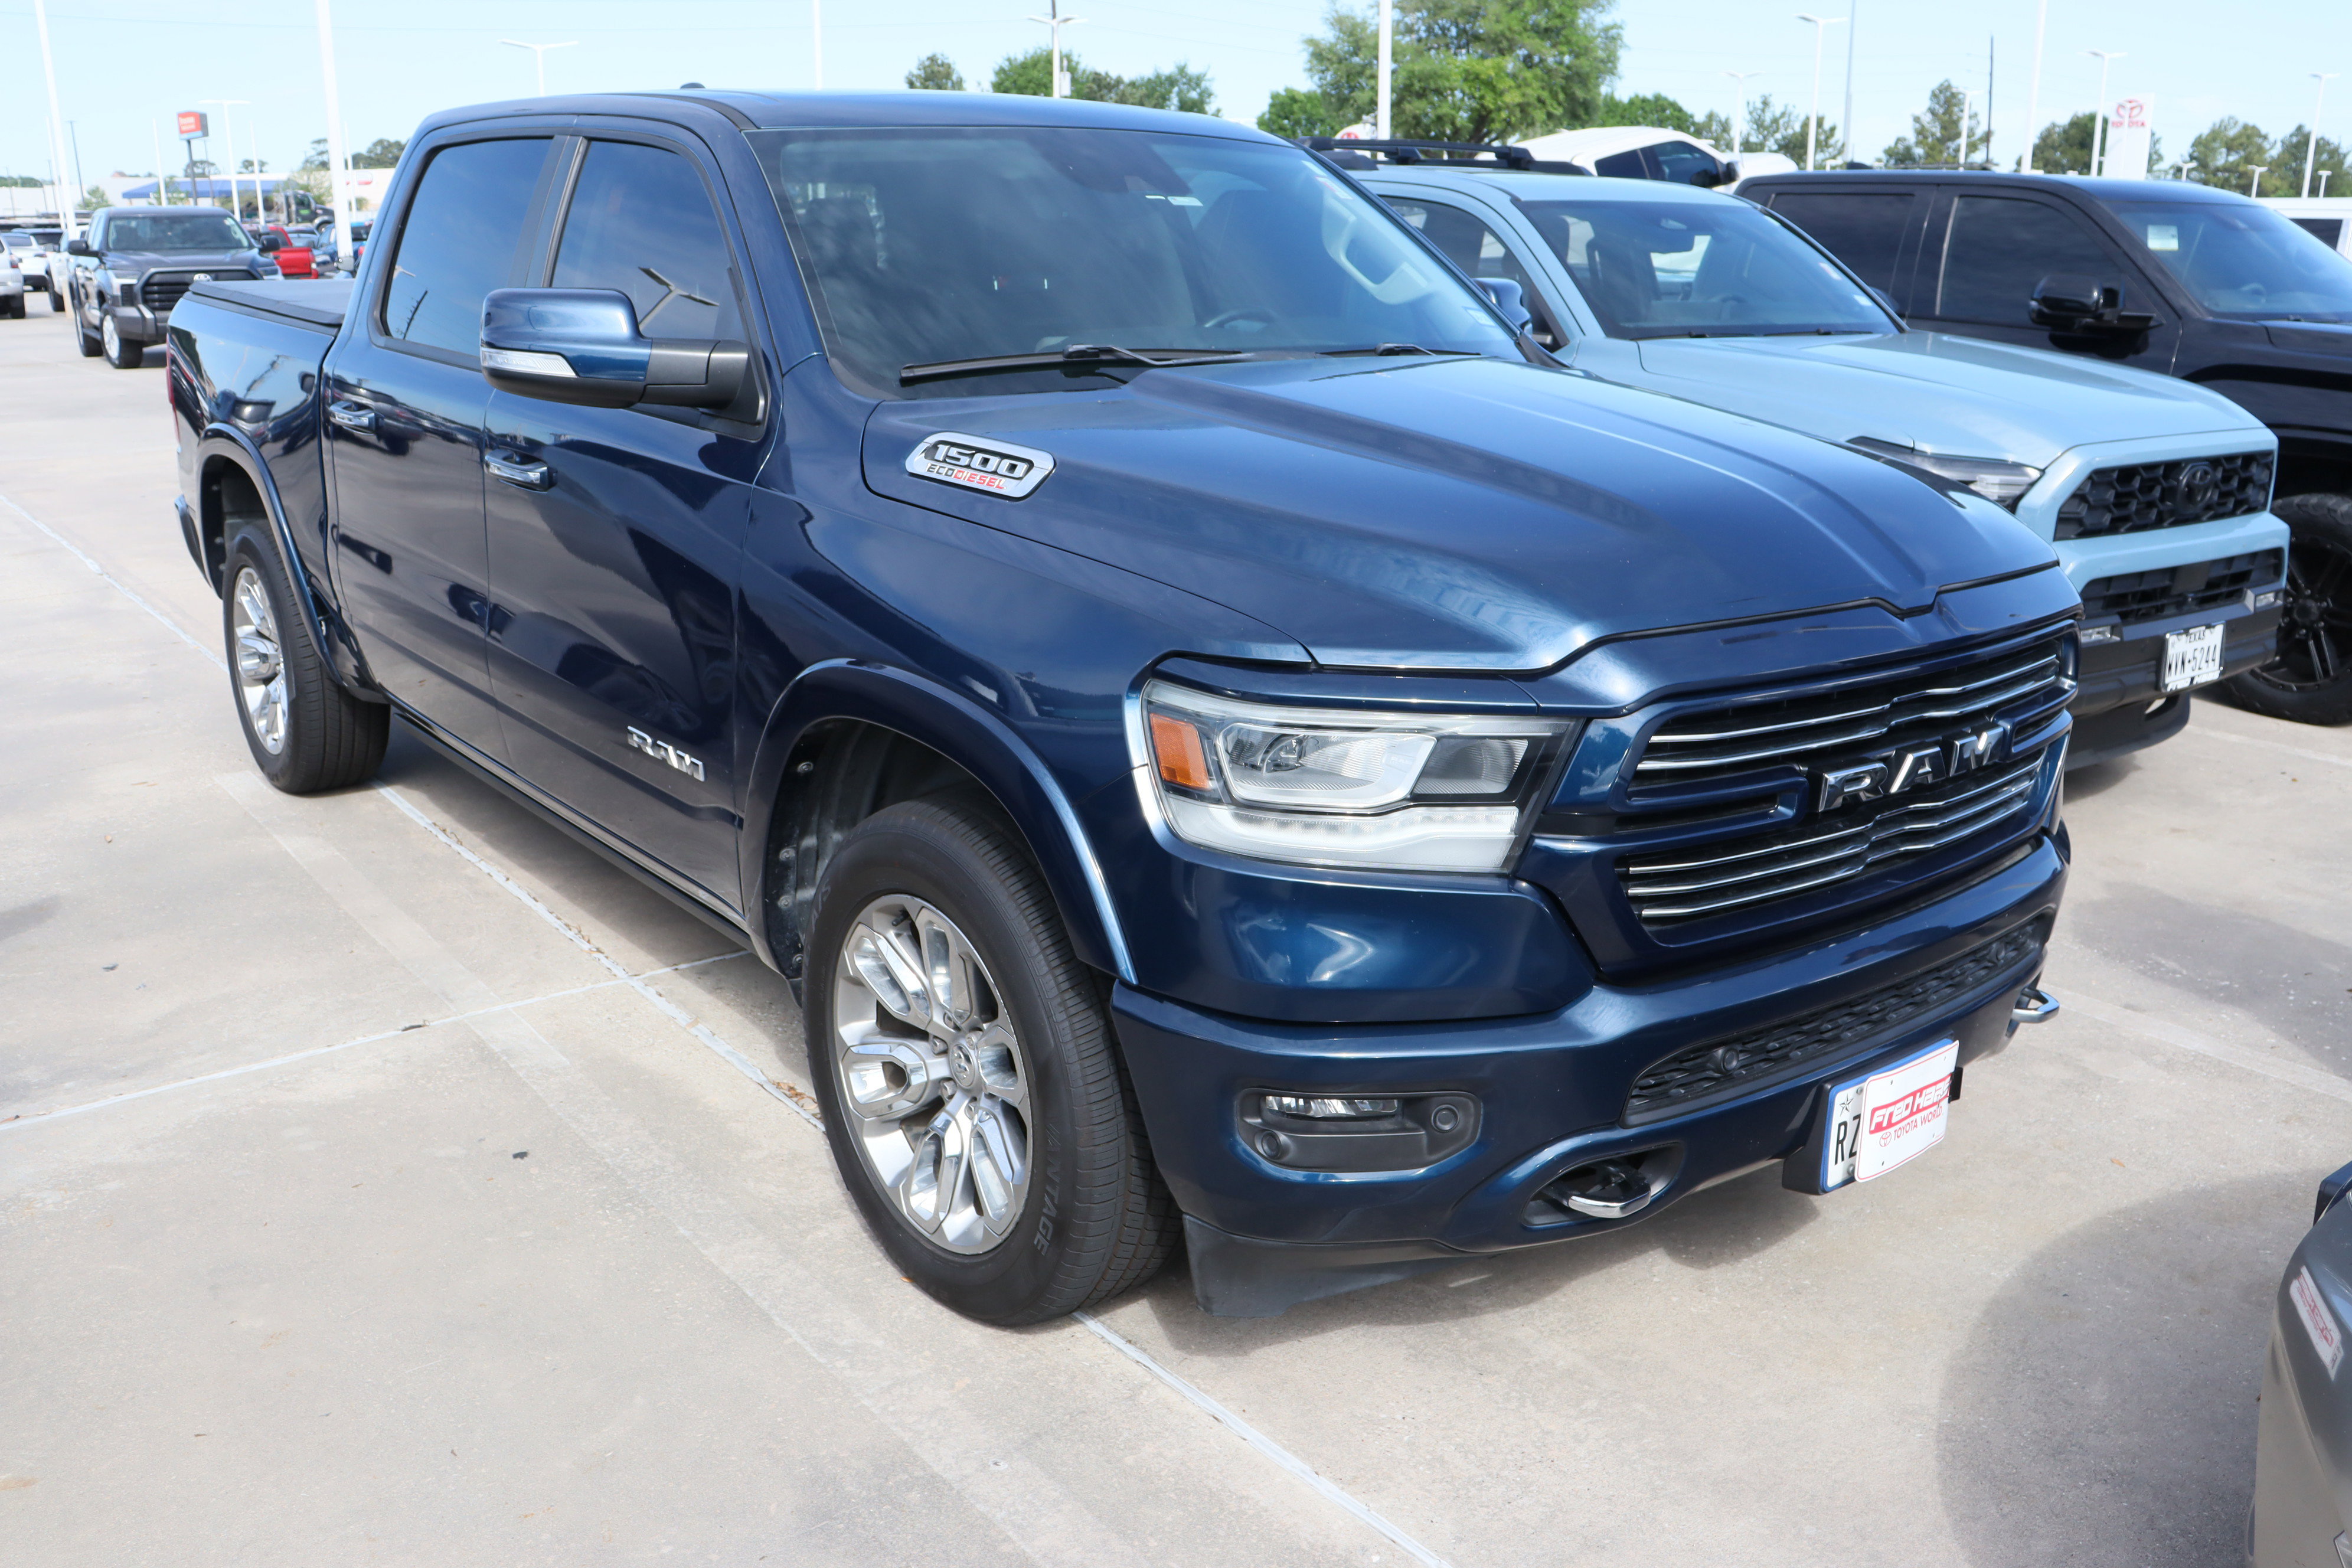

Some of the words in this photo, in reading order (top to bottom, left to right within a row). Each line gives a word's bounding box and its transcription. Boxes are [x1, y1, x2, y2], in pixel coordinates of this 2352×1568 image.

[925, 462, 1007, 489] ECODIESEL
[933, 444, 1030, 478] 1500
[627, 725, 705, 782] RAM
[1818, 726, 2005, 812] RAM
[1894, 1118, 1918, 1141] TOYOTA
[1920, 1106, 1943, 1126] WORLD
